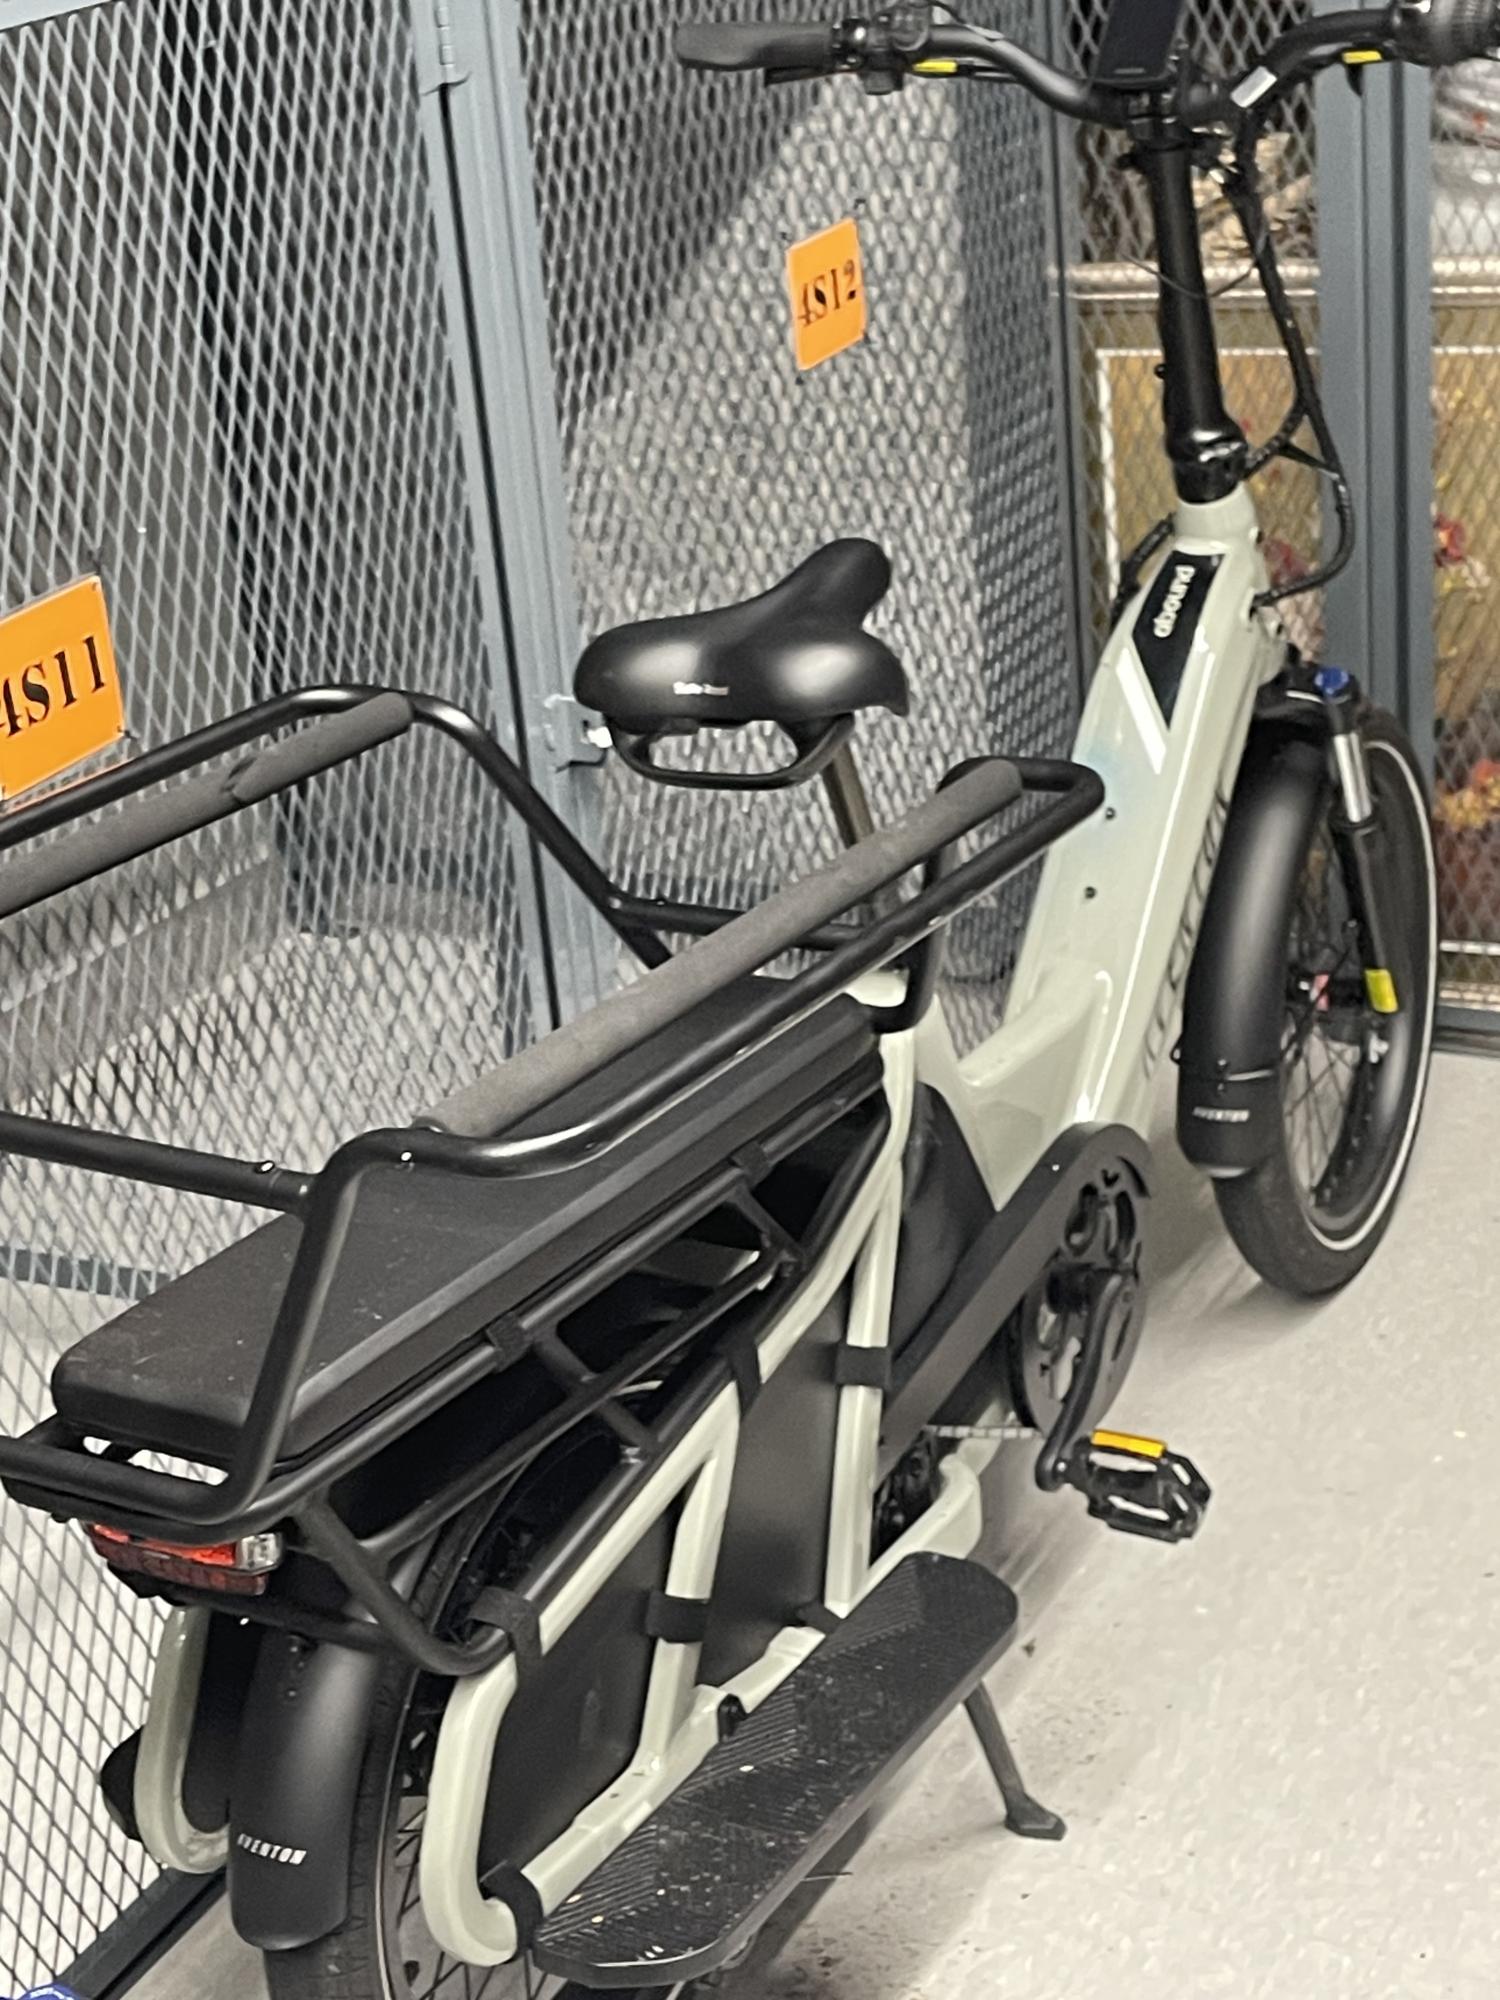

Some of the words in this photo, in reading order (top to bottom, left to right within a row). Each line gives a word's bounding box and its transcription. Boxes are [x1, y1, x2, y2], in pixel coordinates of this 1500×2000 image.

[797, 258, 857, 328] 4S12
[1153, 564, 1195, 638] abound
[0, 635, 105, 738] 4S11
